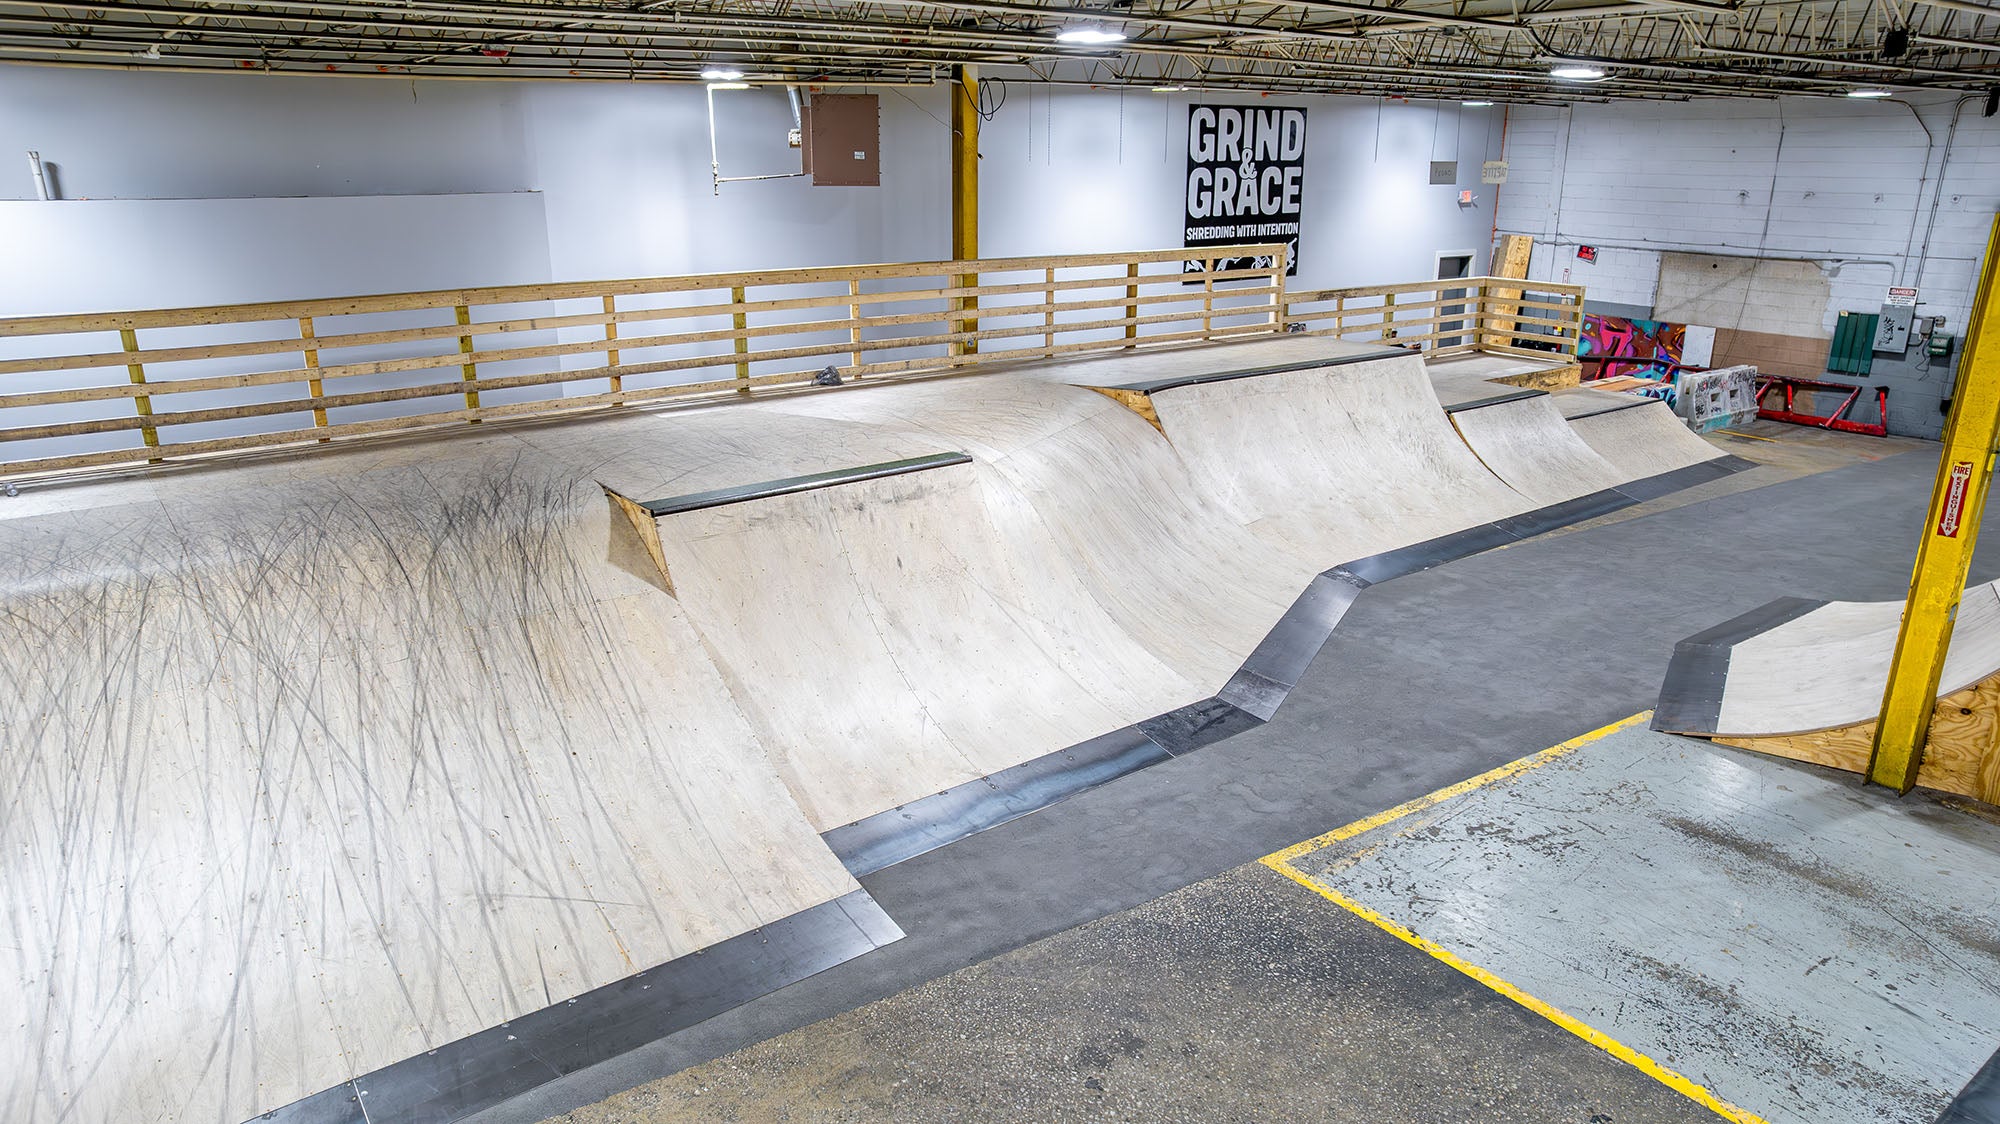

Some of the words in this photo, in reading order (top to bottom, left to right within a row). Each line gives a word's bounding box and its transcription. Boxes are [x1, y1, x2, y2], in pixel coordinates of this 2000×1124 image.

[1190, 107, 1305, 163] GRIND
[1239, 148, 1257, 179] &
[1188, 166, 1302, 219] GRACE
[1186, 226, 1235, 240] SHREDDING
[1236, 224, 1257, 237] WITH
[1257, 222, 1299, 236] INTENTION
[1953, 465, 1970, 476] FIRE
[1945, 476, 1962, 531] EXTINGUISHER
